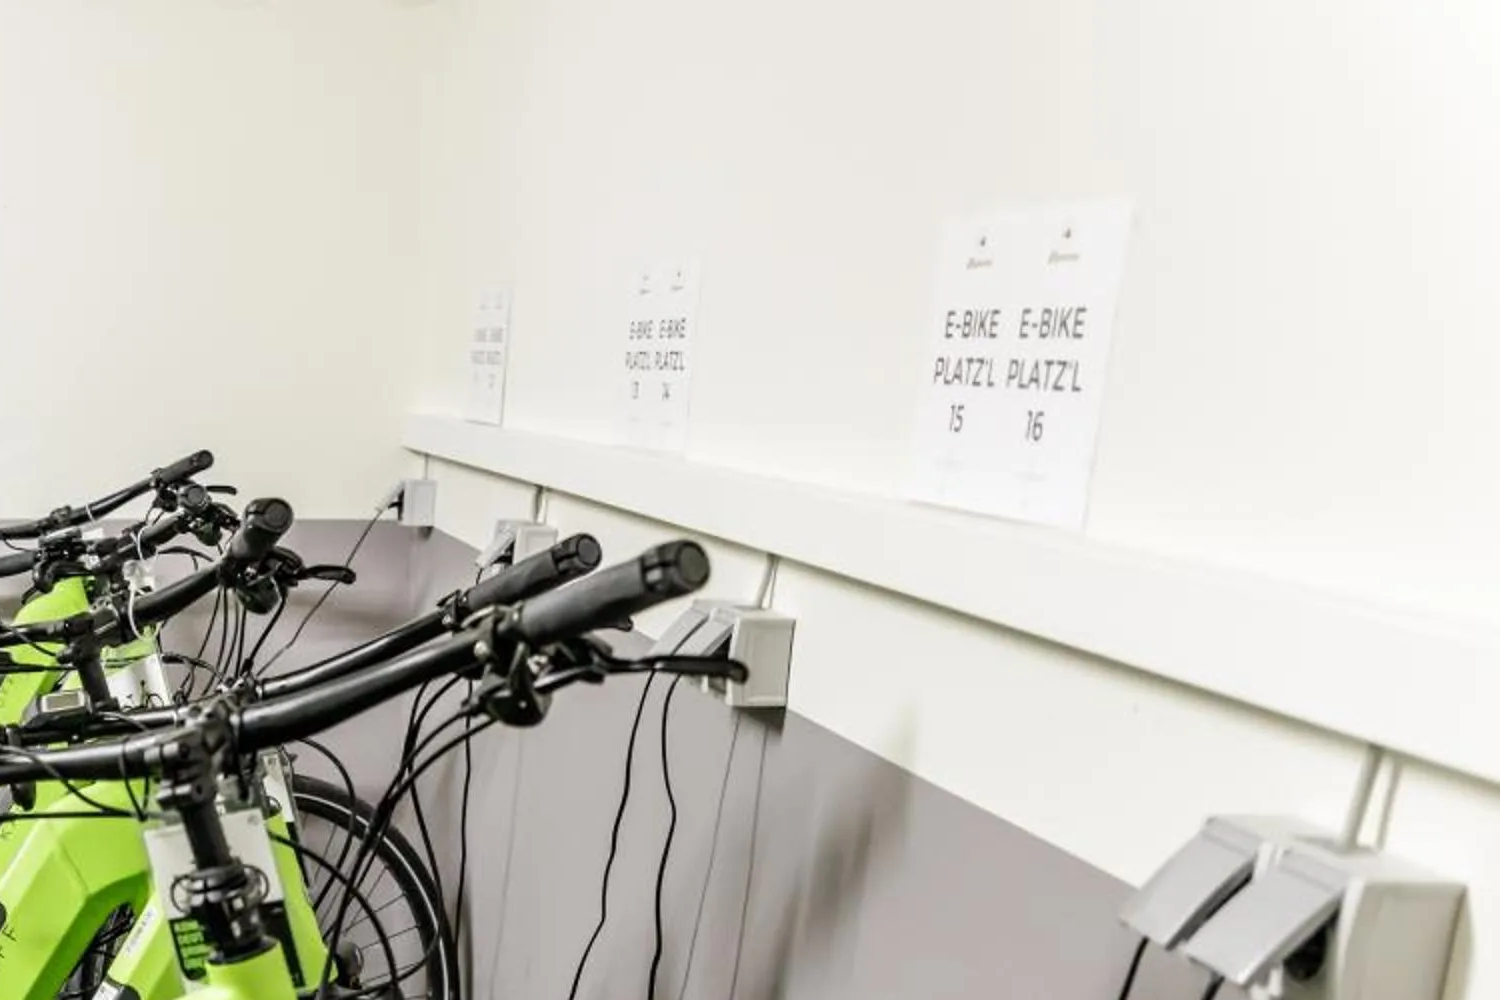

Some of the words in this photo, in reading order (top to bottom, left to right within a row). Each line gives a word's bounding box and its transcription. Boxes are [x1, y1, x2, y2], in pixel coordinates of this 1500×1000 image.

[944, 309, 1001, 339] E-BIKE
[1018, 306, 1087, 340] E-BIKE
[933, 356, 995, 387] PLATZ'L
[1005, 358, 1083, 392] PLATZ'L
[949, 404, 965, 433] 15
[1025, 410, 1045, 442] 16
